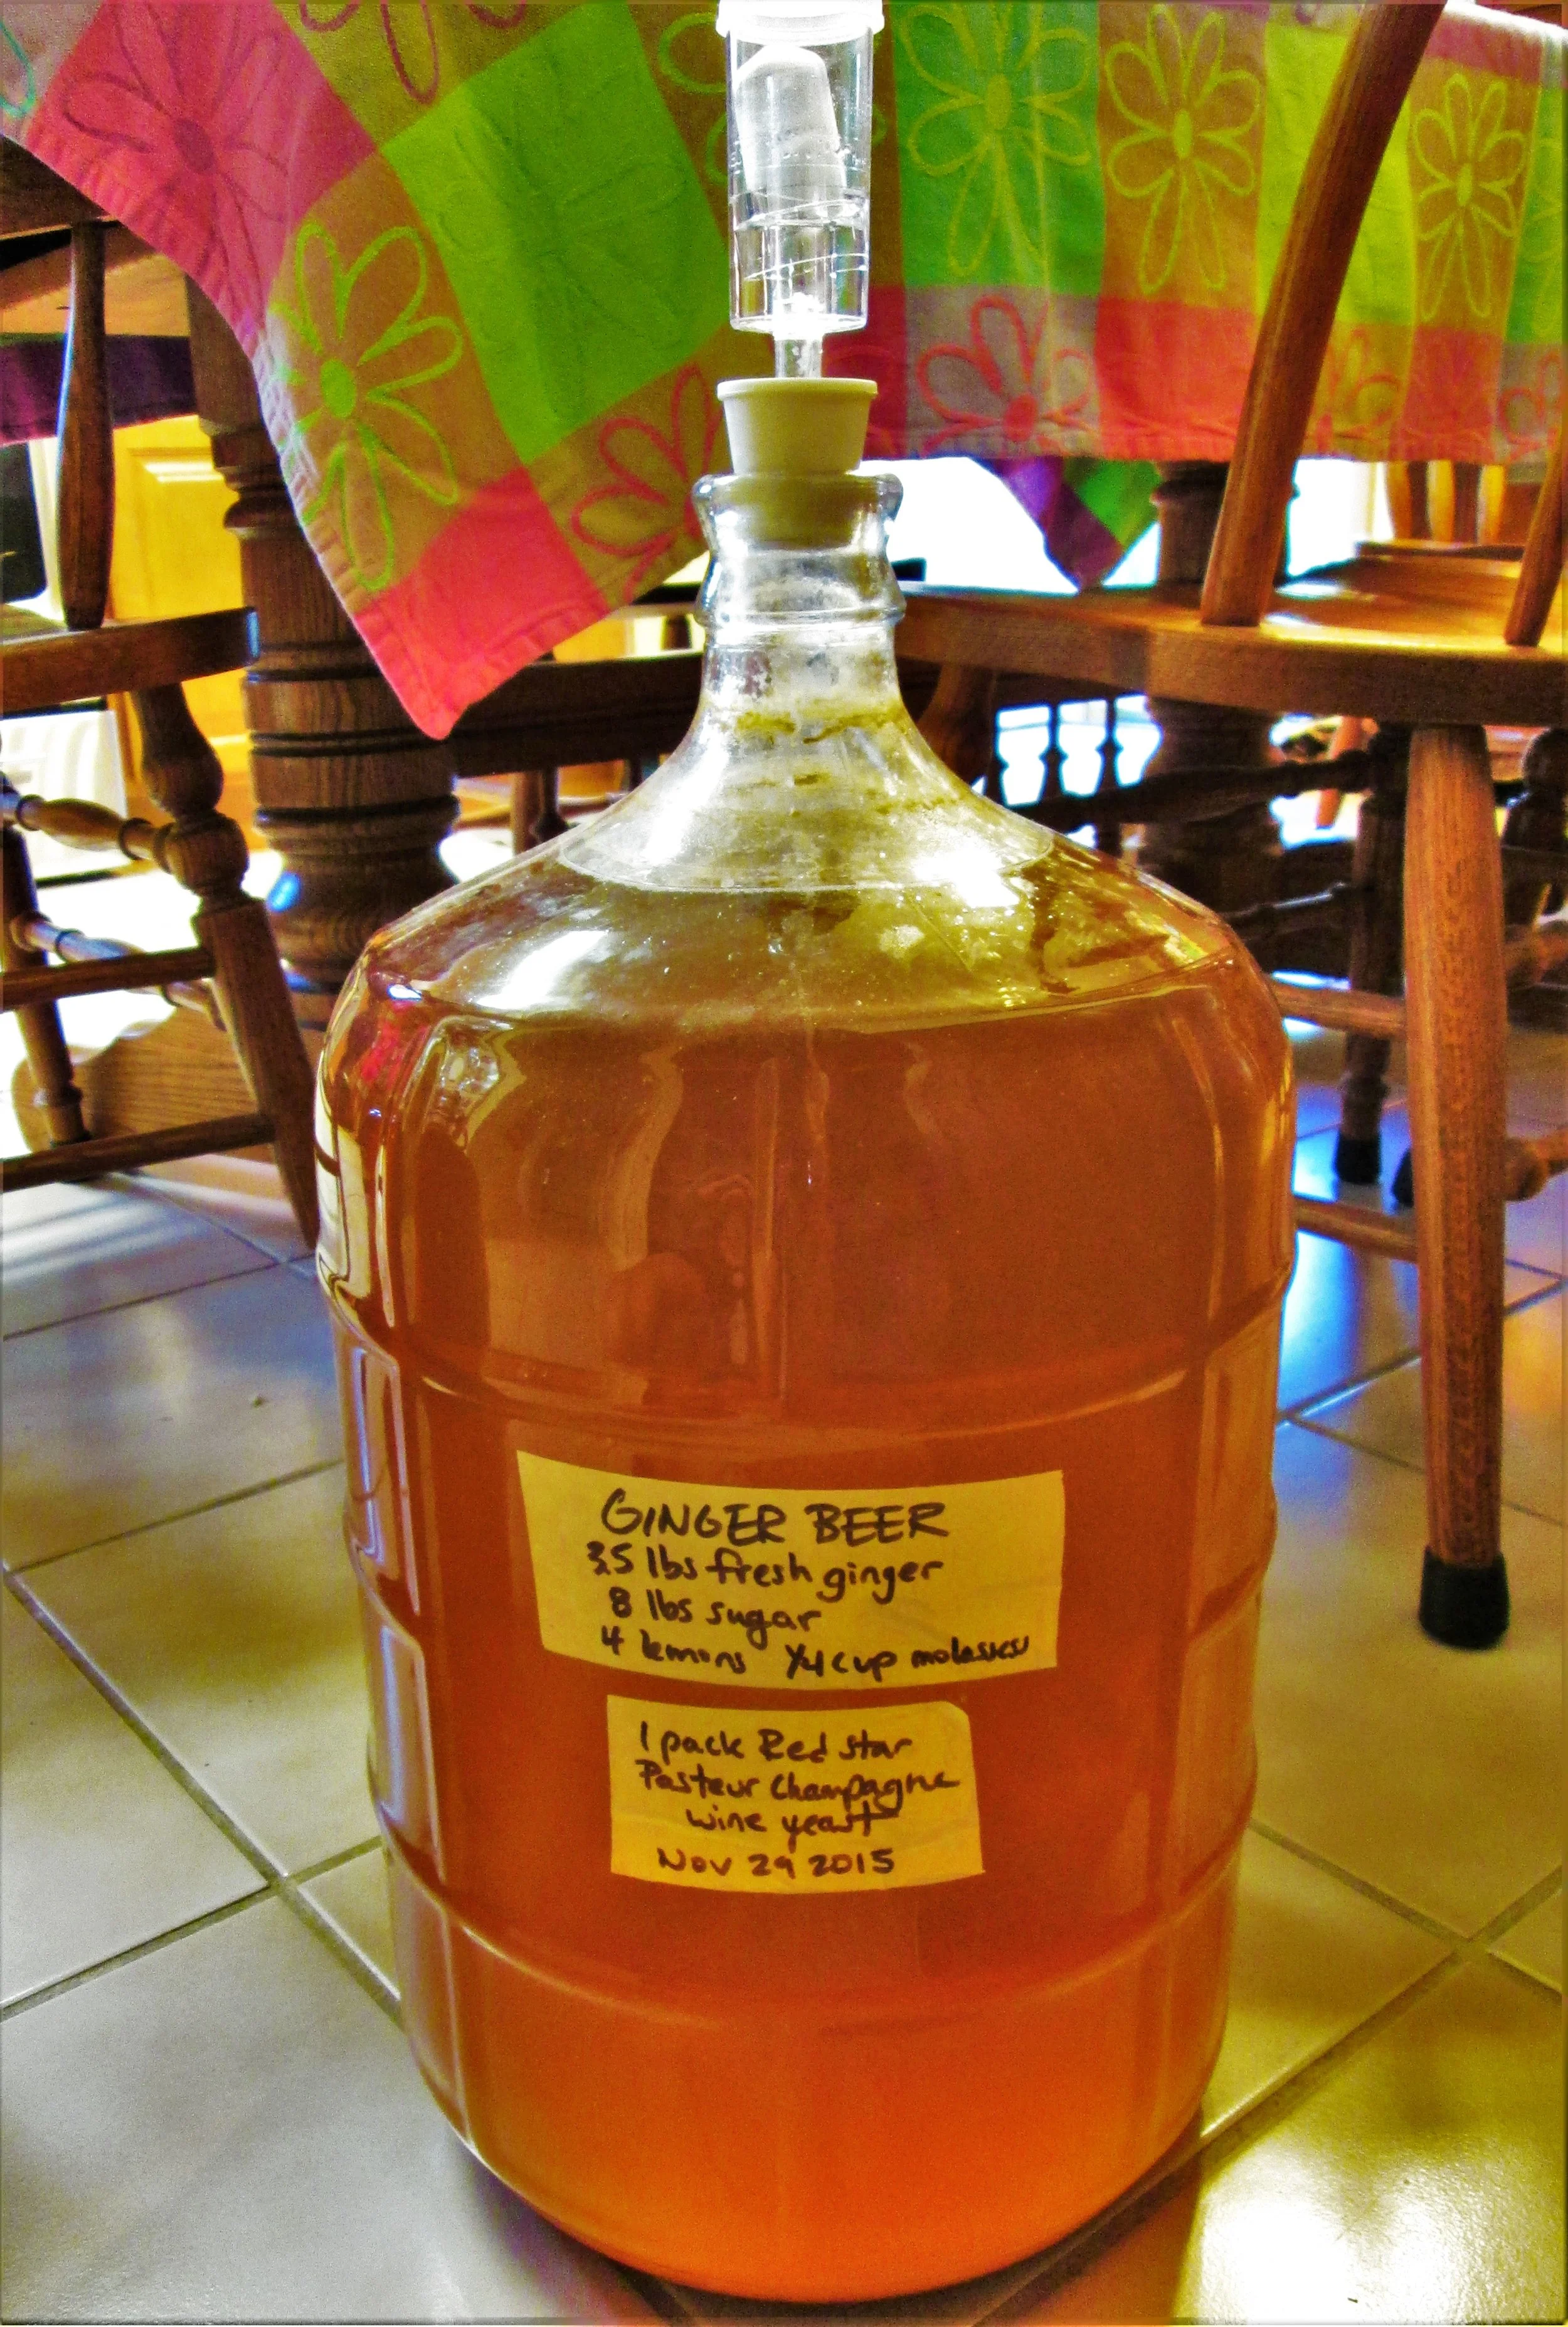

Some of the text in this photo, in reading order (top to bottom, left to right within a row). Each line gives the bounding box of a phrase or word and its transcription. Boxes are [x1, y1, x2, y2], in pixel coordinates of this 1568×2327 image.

[601, 1488, 950, 1547] GINGER BEER
[646, 1544, 698, 1581] lbs
[705, 1547, 813, 1587] fresh
[816, 1561, 944, 1604] ginger
[608, 1586, 821, 1651] 8 lbs sugar
[601, 1625, 624, 1656] 4
[832, 1650, 898, 1683] cup
[640, 1720, 649, 1752] 1
[660, 1730, 744, 1766] pack
[757, 1729, 827, 1764] Red
[781, 1801, 899, 1854] yeast
[748, 1853, 796, 1880] 29
[808, 1848, 895, 1878] 2015
